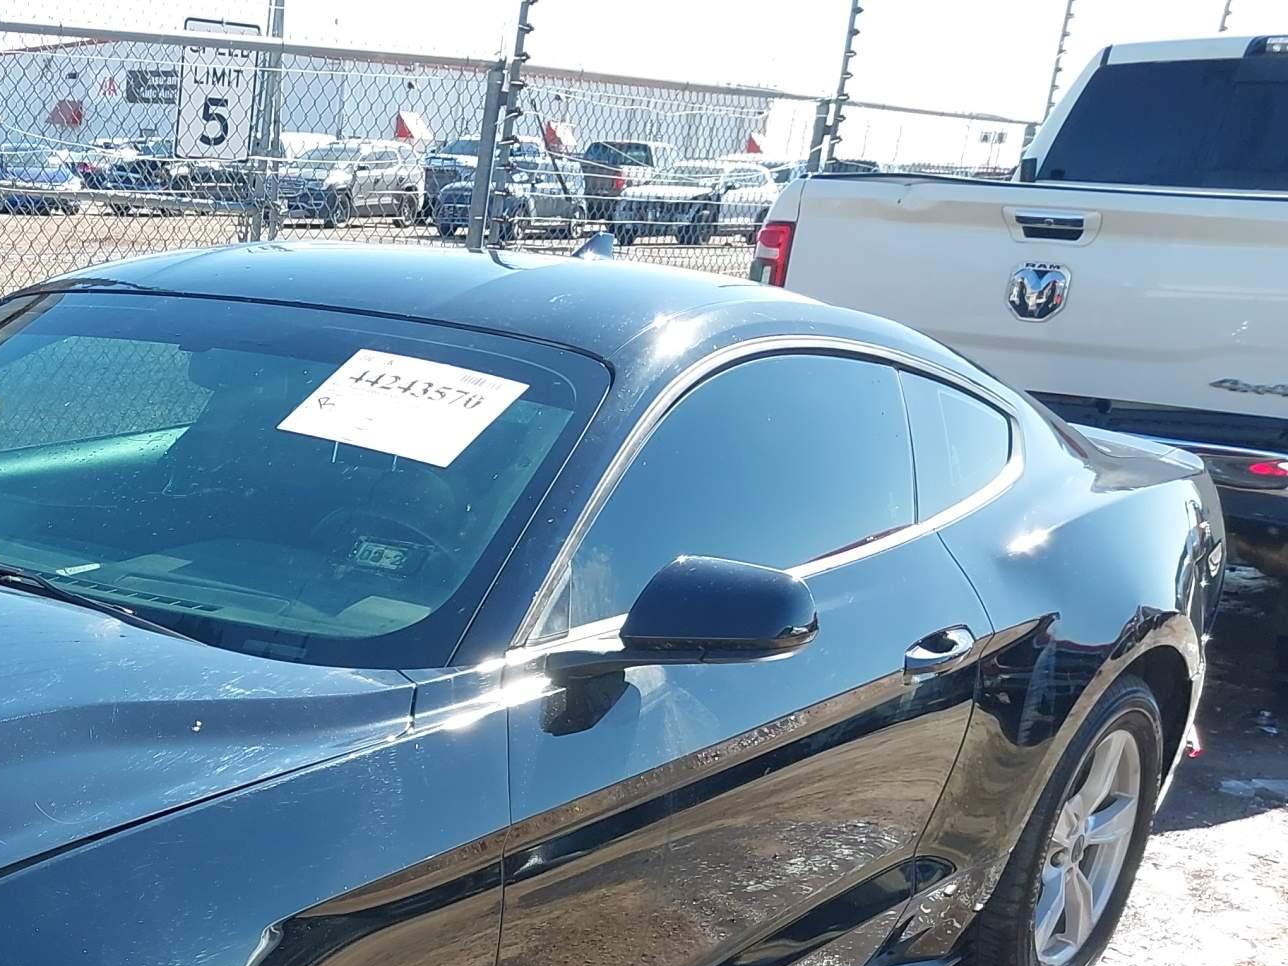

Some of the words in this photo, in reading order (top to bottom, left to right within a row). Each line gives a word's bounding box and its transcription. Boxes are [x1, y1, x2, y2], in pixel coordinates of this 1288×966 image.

[193, 66, 244, 88] LIMIT
[199, 97, 229, 146] 5
[1024, 262, 1062, 270] RAM
[349, 369, 484, 410] 44243570
